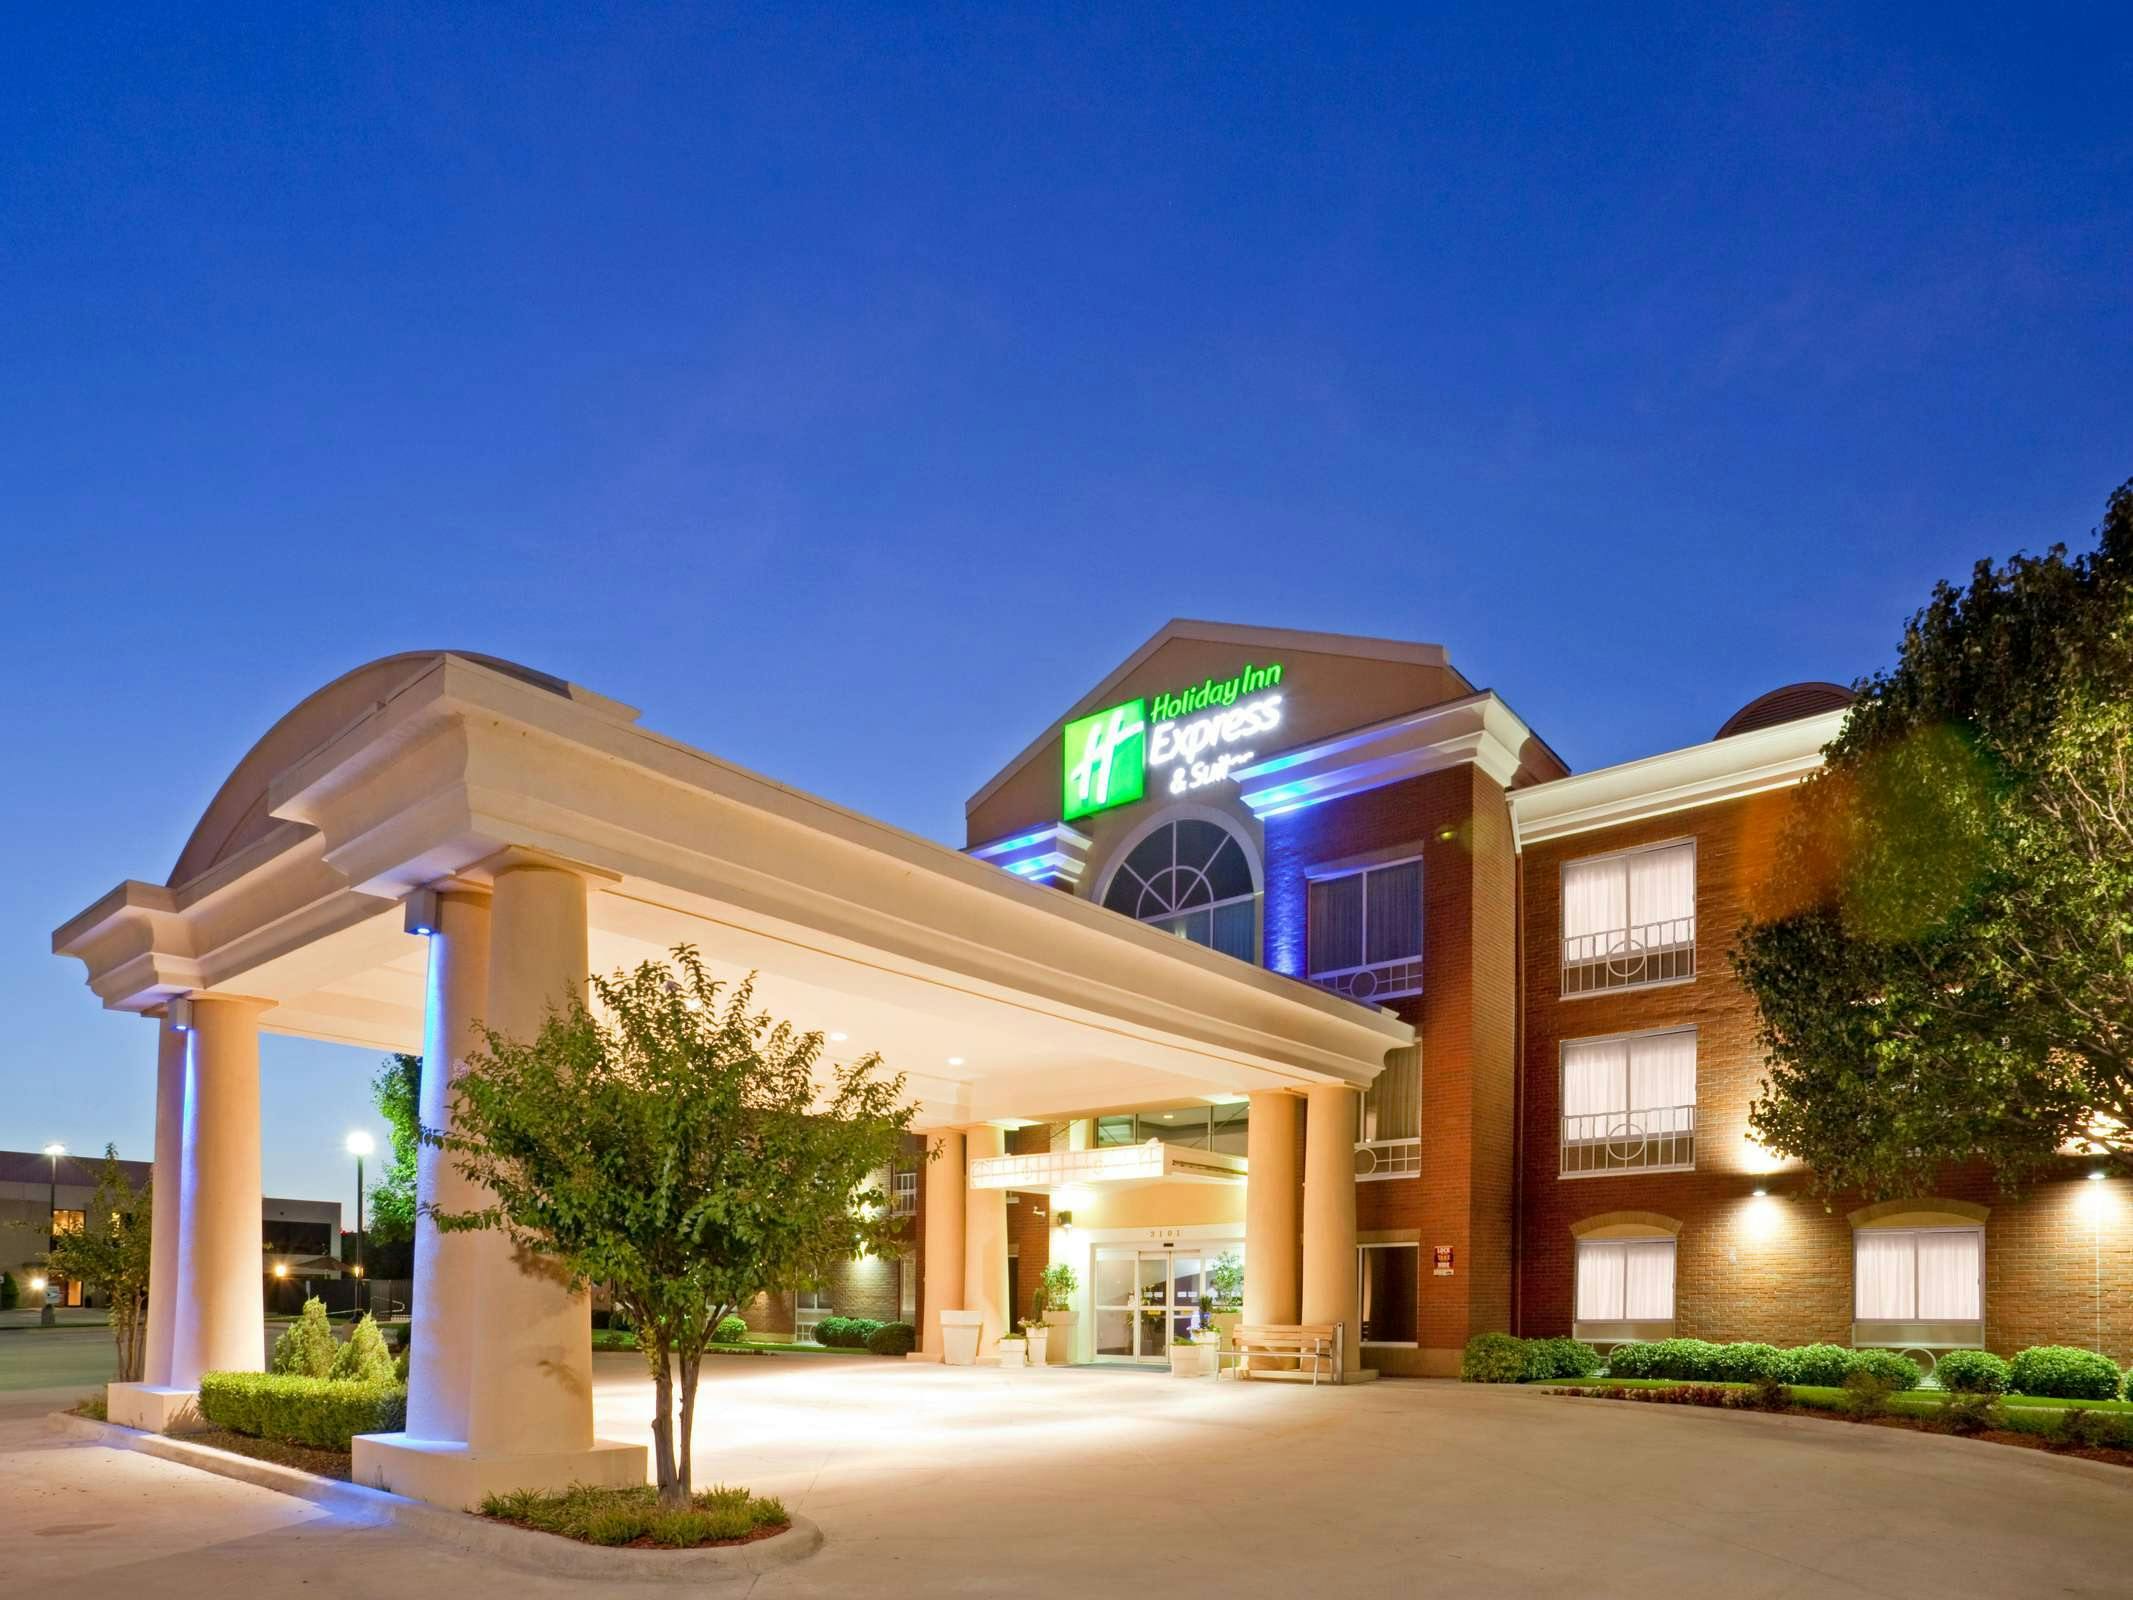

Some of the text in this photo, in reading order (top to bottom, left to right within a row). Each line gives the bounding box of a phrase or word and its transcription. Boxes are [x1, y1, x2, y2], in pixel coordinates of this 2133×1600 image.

[1150, 663, 1284, 724] Holiday Inn
[1149, 696, 1283, 766] Express
[1169, 766, 1187, 795] &
